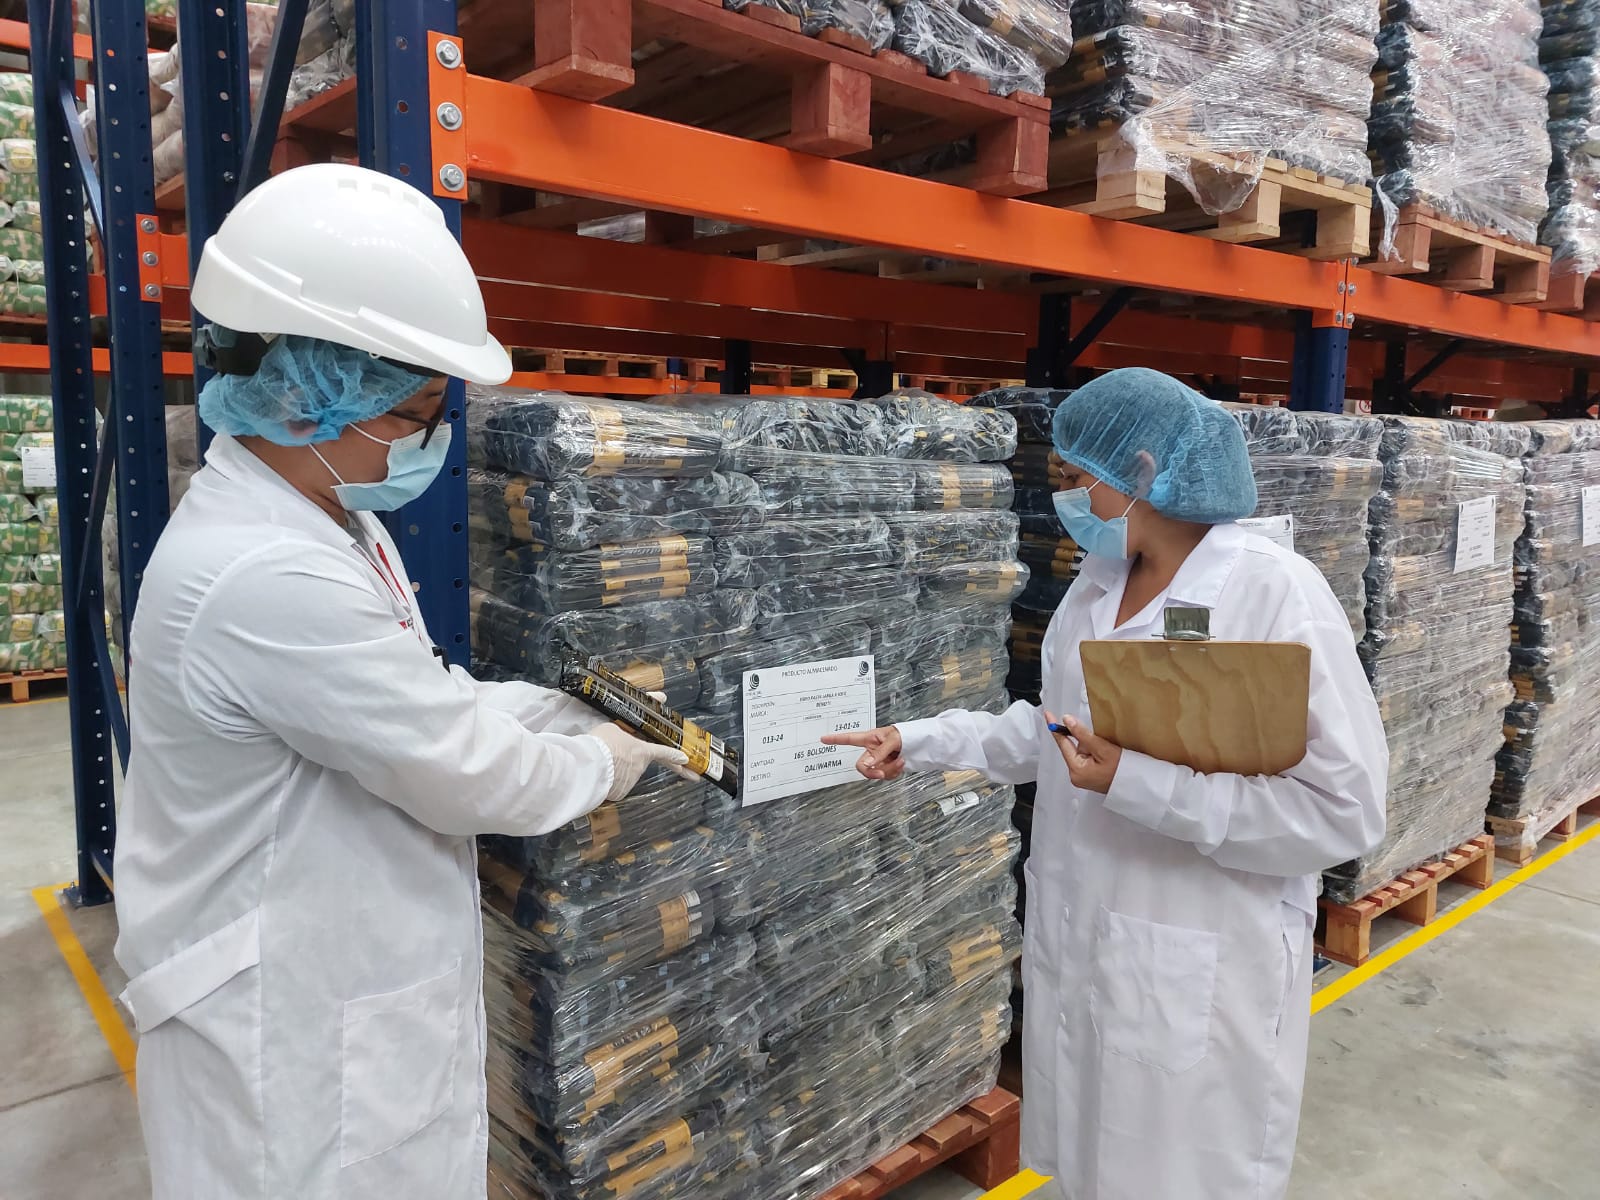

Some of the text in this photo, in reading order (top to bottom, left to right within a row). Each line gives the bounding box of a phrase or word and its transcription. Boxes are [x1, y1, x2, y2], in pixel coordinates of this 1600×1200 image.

[782, 665, 838, 678] PRODUCTO ALMACENADO
[834, 721, 860, 732] 13-01-26
[762, 734, 784, 744] 013-24
[794, 745, 837, 760] 165 BOLSONES
[804, 759, 842, 773] QALIWARMA
